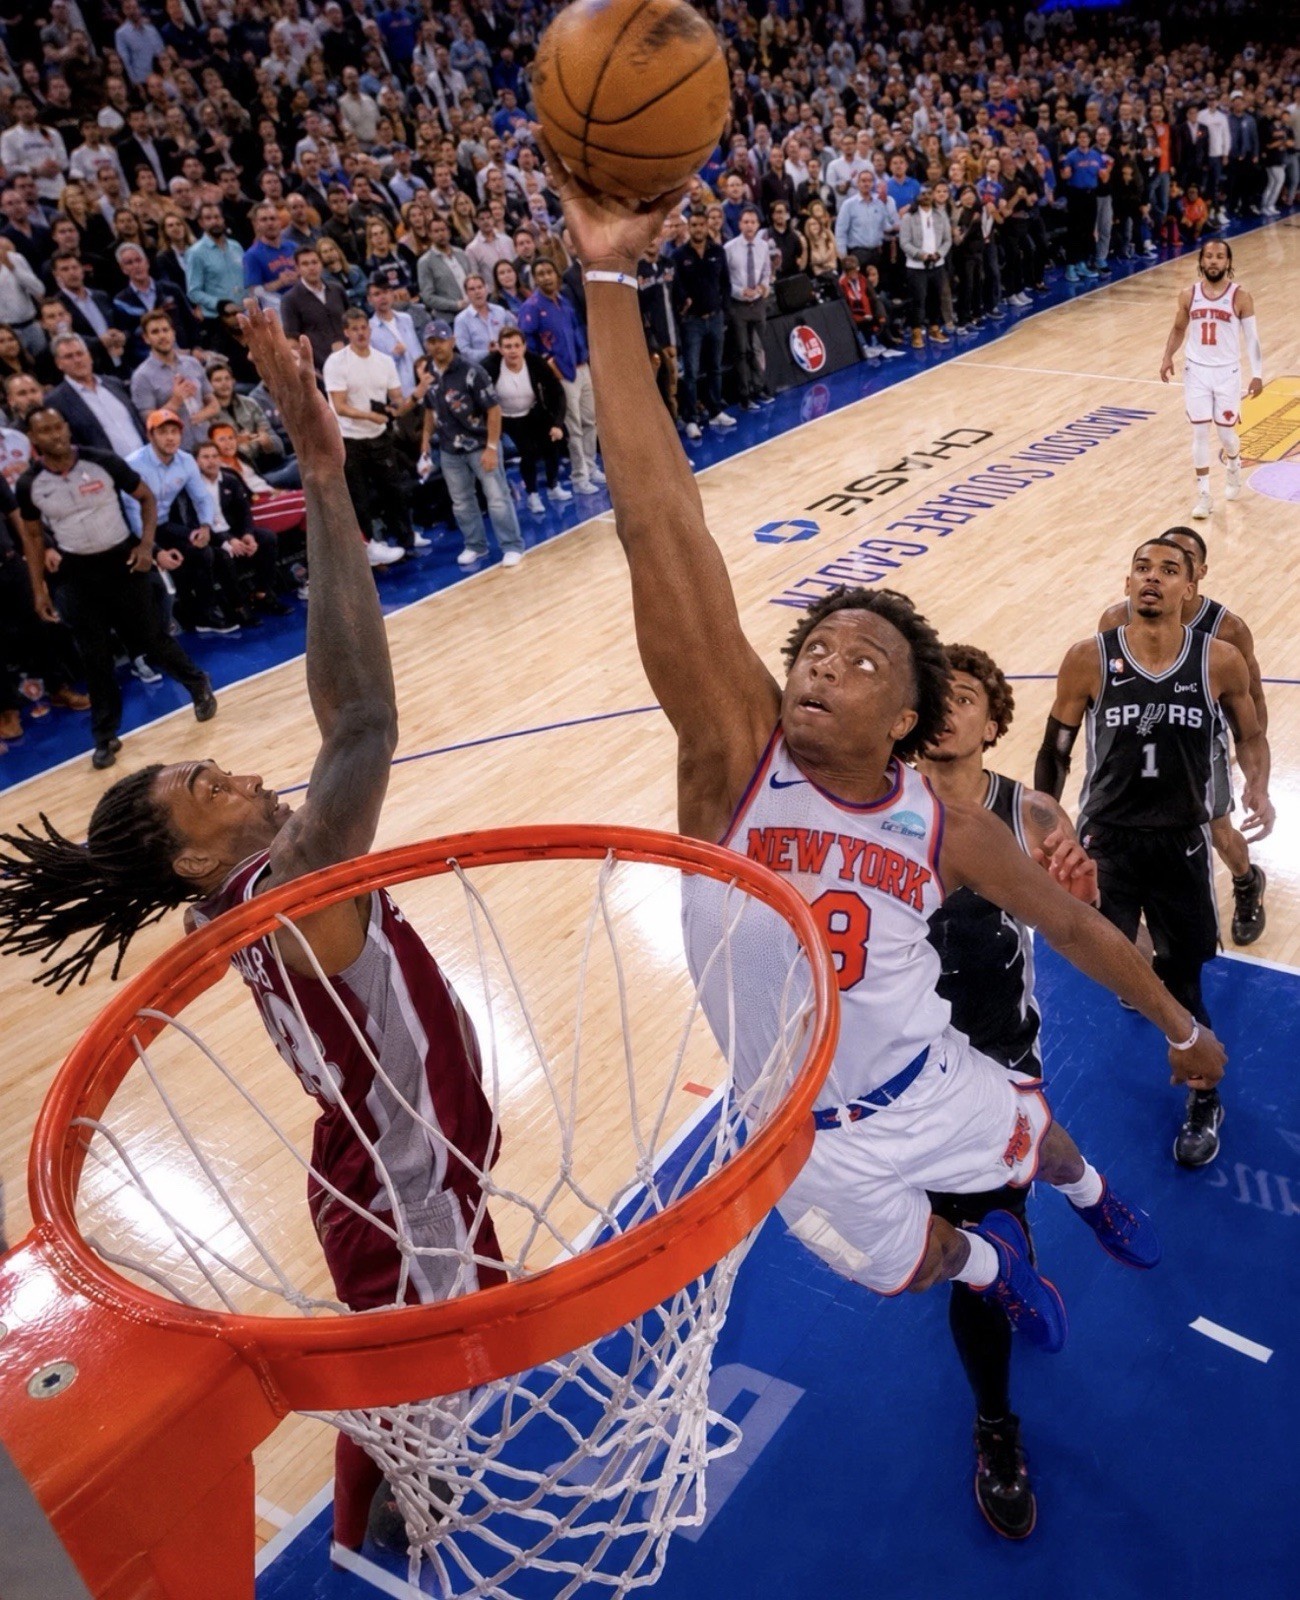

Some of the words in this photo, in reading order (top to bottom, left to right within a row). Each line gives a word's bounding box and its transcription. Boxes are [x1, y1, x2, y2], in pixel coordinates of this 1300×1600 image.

[1201, 322, 1216, 345] 11
[1010, 405, 1158, 466] MADISON
[805, 428, 993, 517] CHASE
[886, 463, 1055, 538] SQUARE
[1105, 703, 1202, 737] SPURS
[1141, 744, 1159, 778] 1
[747, 828, 836, 874] NEW
[837, 834, 931, 912] YORK
[799, 889, 872, 991] 8
